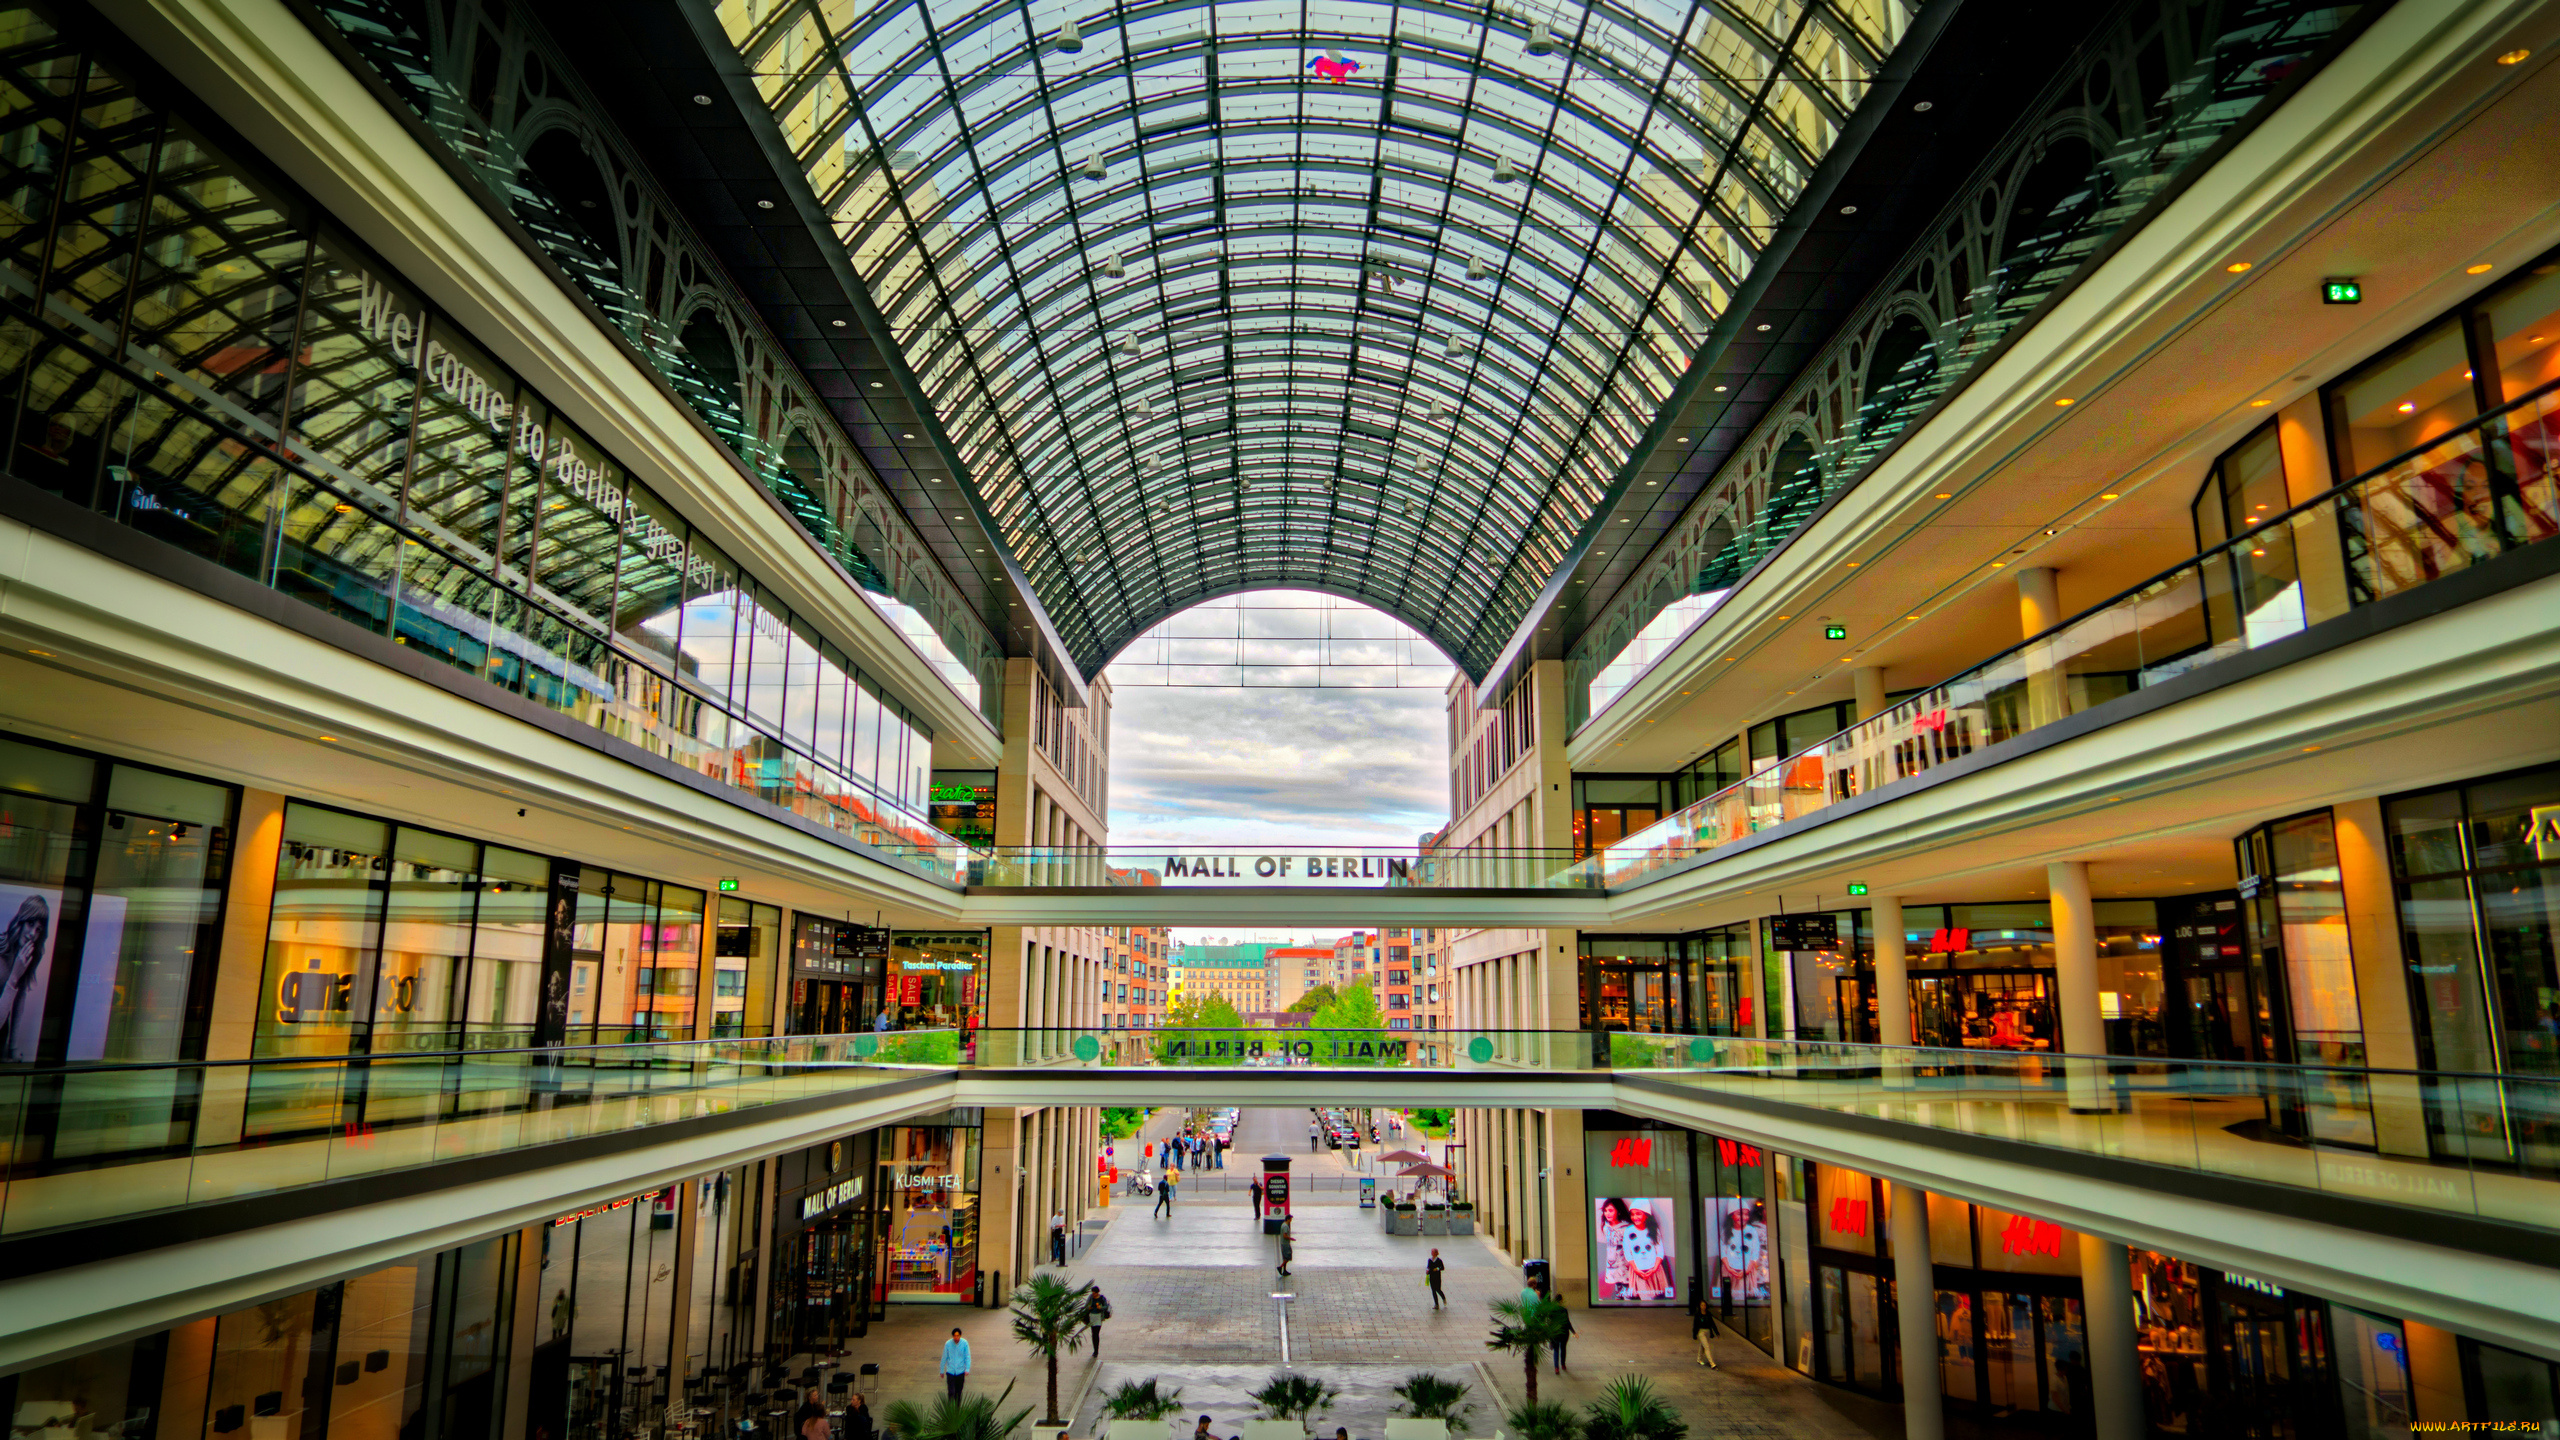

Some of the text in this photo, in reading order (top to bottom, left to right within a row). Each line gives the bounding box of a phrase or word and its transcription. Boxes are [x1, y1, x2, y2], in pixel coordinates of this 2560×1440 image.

[360, 268, 506, 432] Welcome
[518, 405, 545, 462] to
[557, 436, 639, 534] Berlin's
[1164, 856, 1408, 878] MALL OF BERLIN
[1930, 927, 1969, 954] H&M
[902, 961, 973, 970] Taschen Paradies
[886, 975, 894, 1001] SALE
[906, 977, 916, 1002] SALE
[965, 977, 973, 1002] SALE
[1610, 1138, 1652, 1168] H&M
[895, 1172, 961, 1191] KUSMI TEA
[803, 1175, 863, 1220] MALL OF BERLIN
[1829, 1197, 1867, 1238] H&M
[2001, 1214, 2062, 1259] H&M
